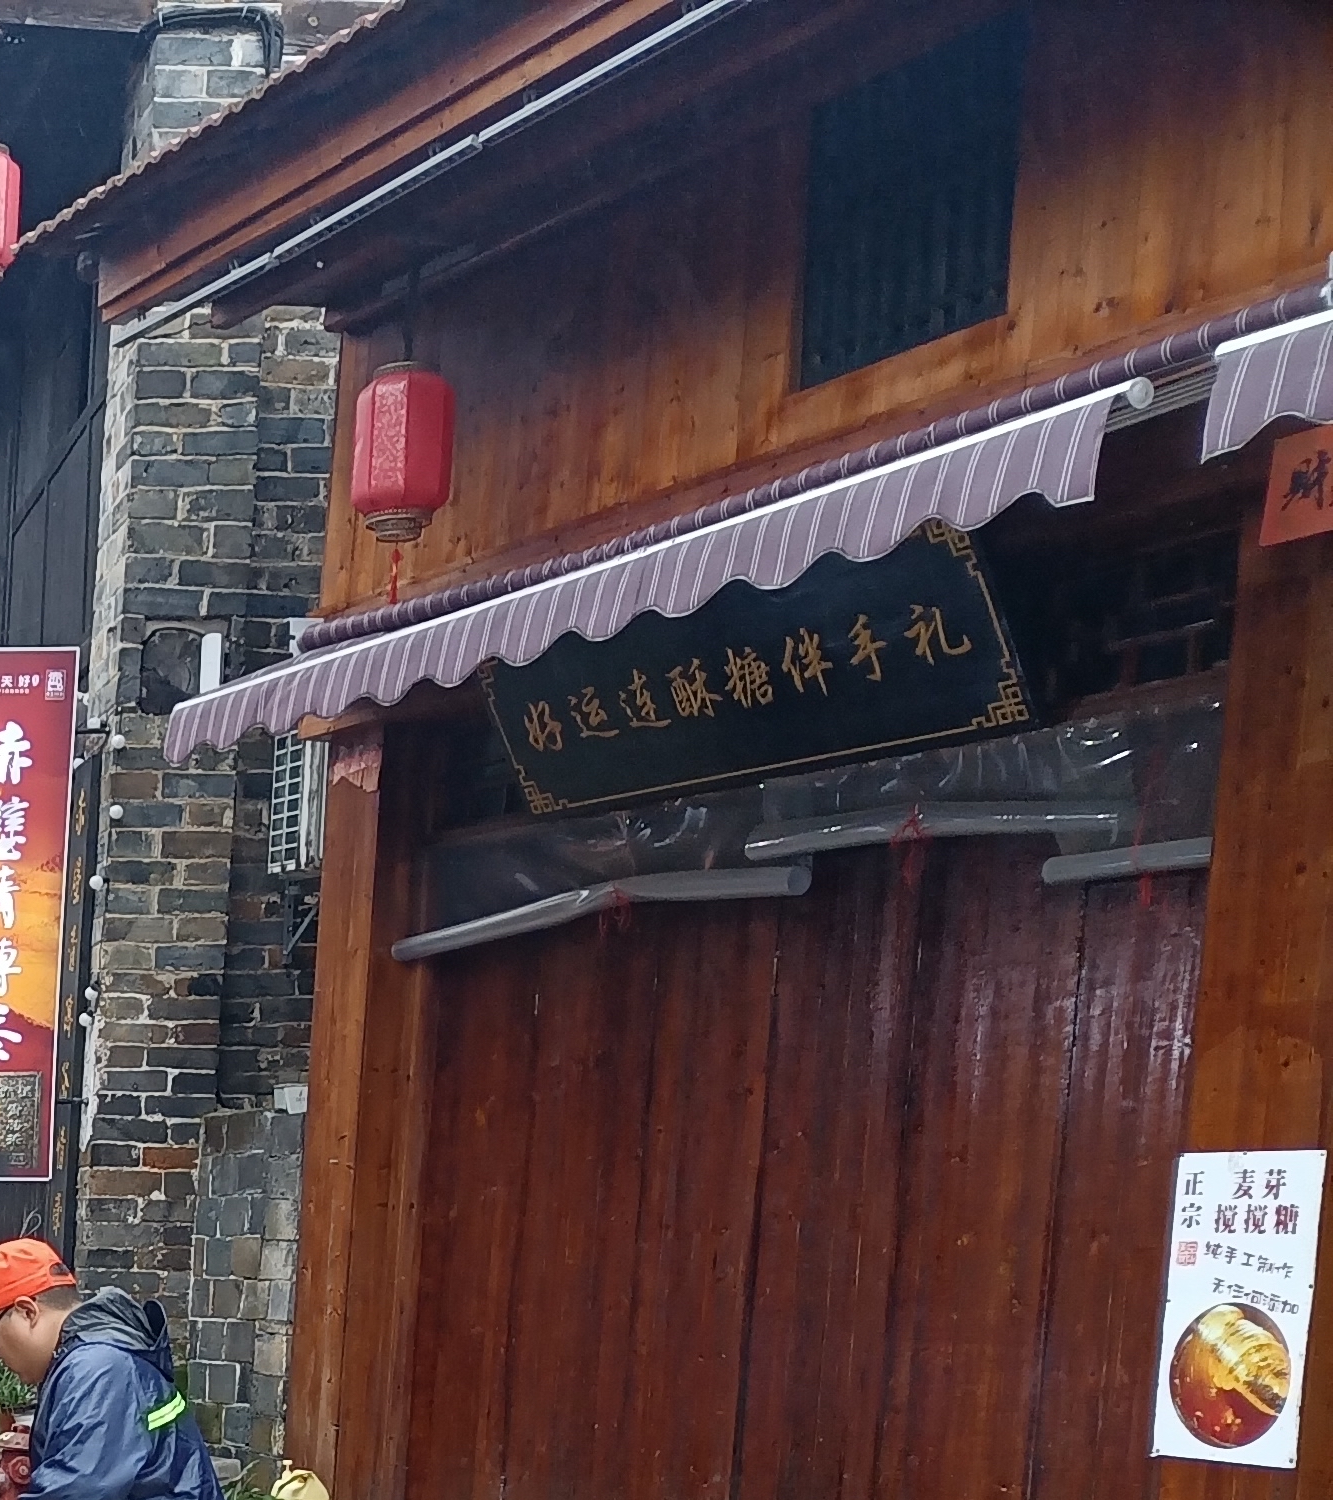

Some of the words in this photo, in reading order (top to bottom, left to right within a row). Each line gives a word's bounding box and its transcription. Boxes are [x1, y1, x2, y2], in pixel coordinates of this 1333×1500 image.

[1181, 1169, 1206, 1229] 正宗
[1233, 1168, 1287, 1201] 麦芽
[1214, 1203, 1300, 1235] 搅搅糖
[1203, 1240, 1295, 1279] 纯手工制作
[1212, 1277, 1300, 1315] 无任何添加
